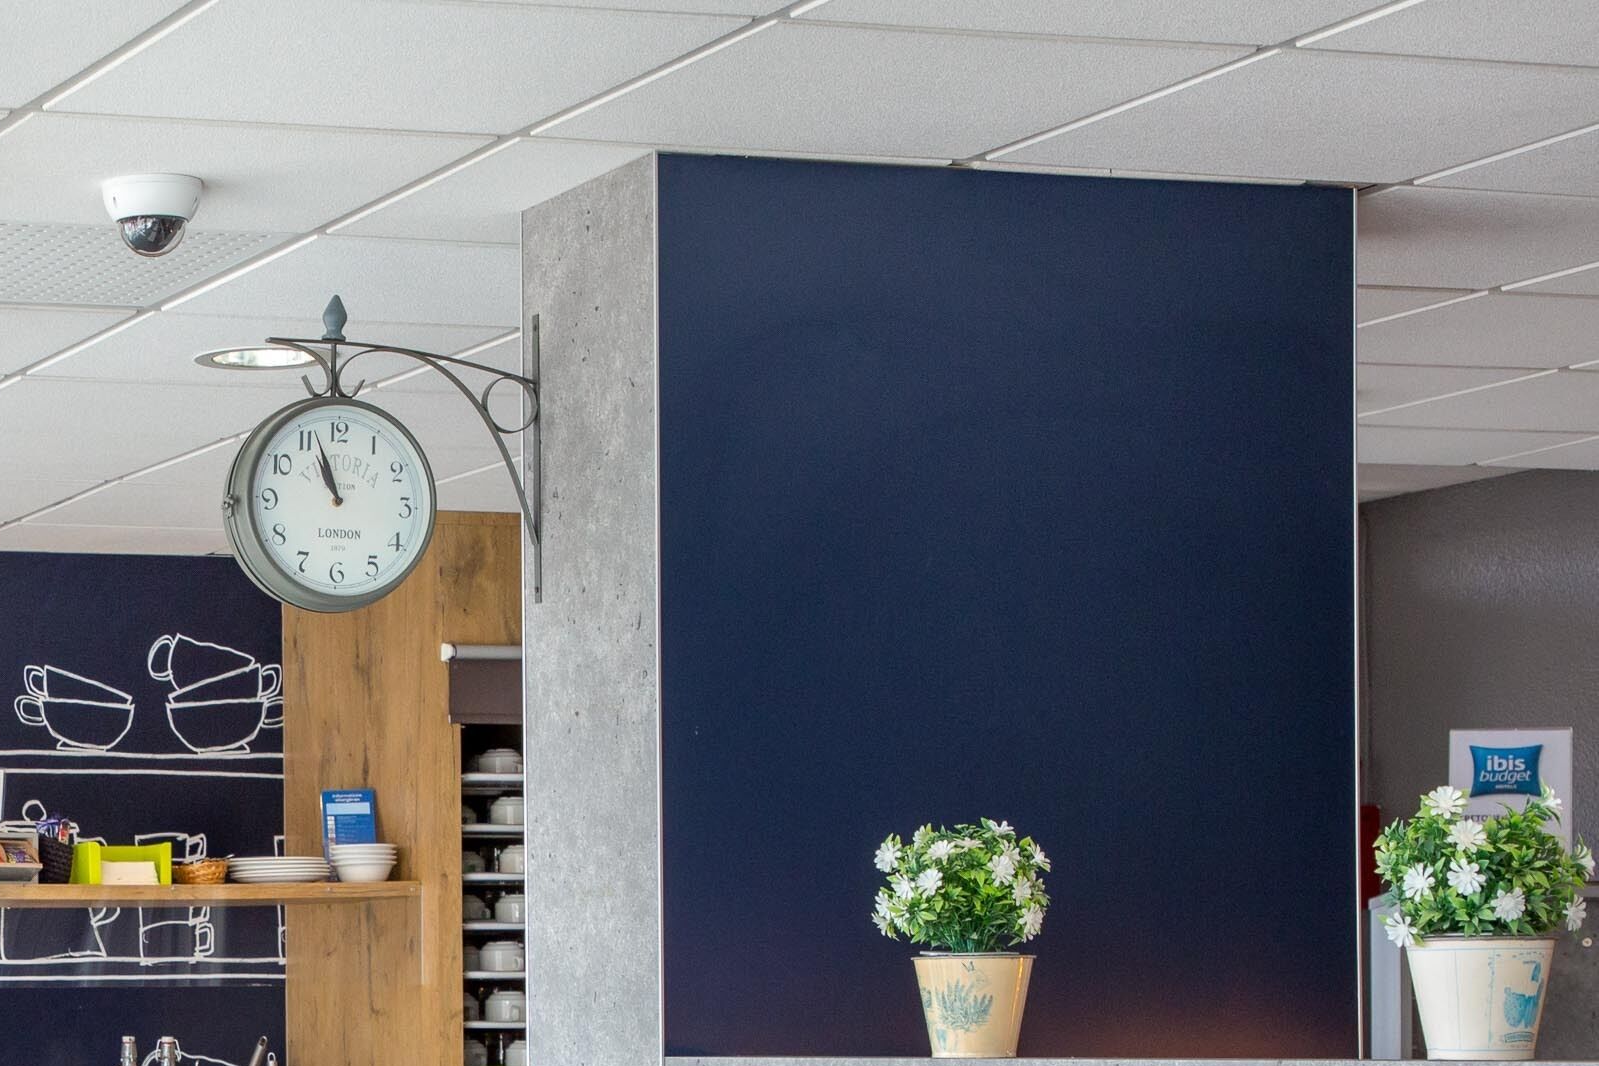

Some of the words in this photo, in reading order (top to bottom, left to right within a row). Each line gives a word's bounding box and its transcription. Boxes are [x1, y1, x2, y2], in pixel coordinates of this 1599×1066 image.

[299, 430, 312, 451] 11
[330, 421, 349, 443] 12
[371, 435, 376, 455] 1
[272, 453, 292, 475] 10
[298, 453, 379, 488] VITORIA
[390, 460, 403, 483] 2
[261, 487, 278, 510] 9
[398, 497, 412, 519] 3
[271, 523, 286, 546] 8
[317, 528, 361, 540] LONDON
[387, 532, 404, 552] 4
[296, 551, 309, 573] 7
[329, 561, 345, 584] 6
[365, 555, 379, 578] 5
[1486, 755, 1525, 771] ibis
[1479, 770, 1531, 784] budget
